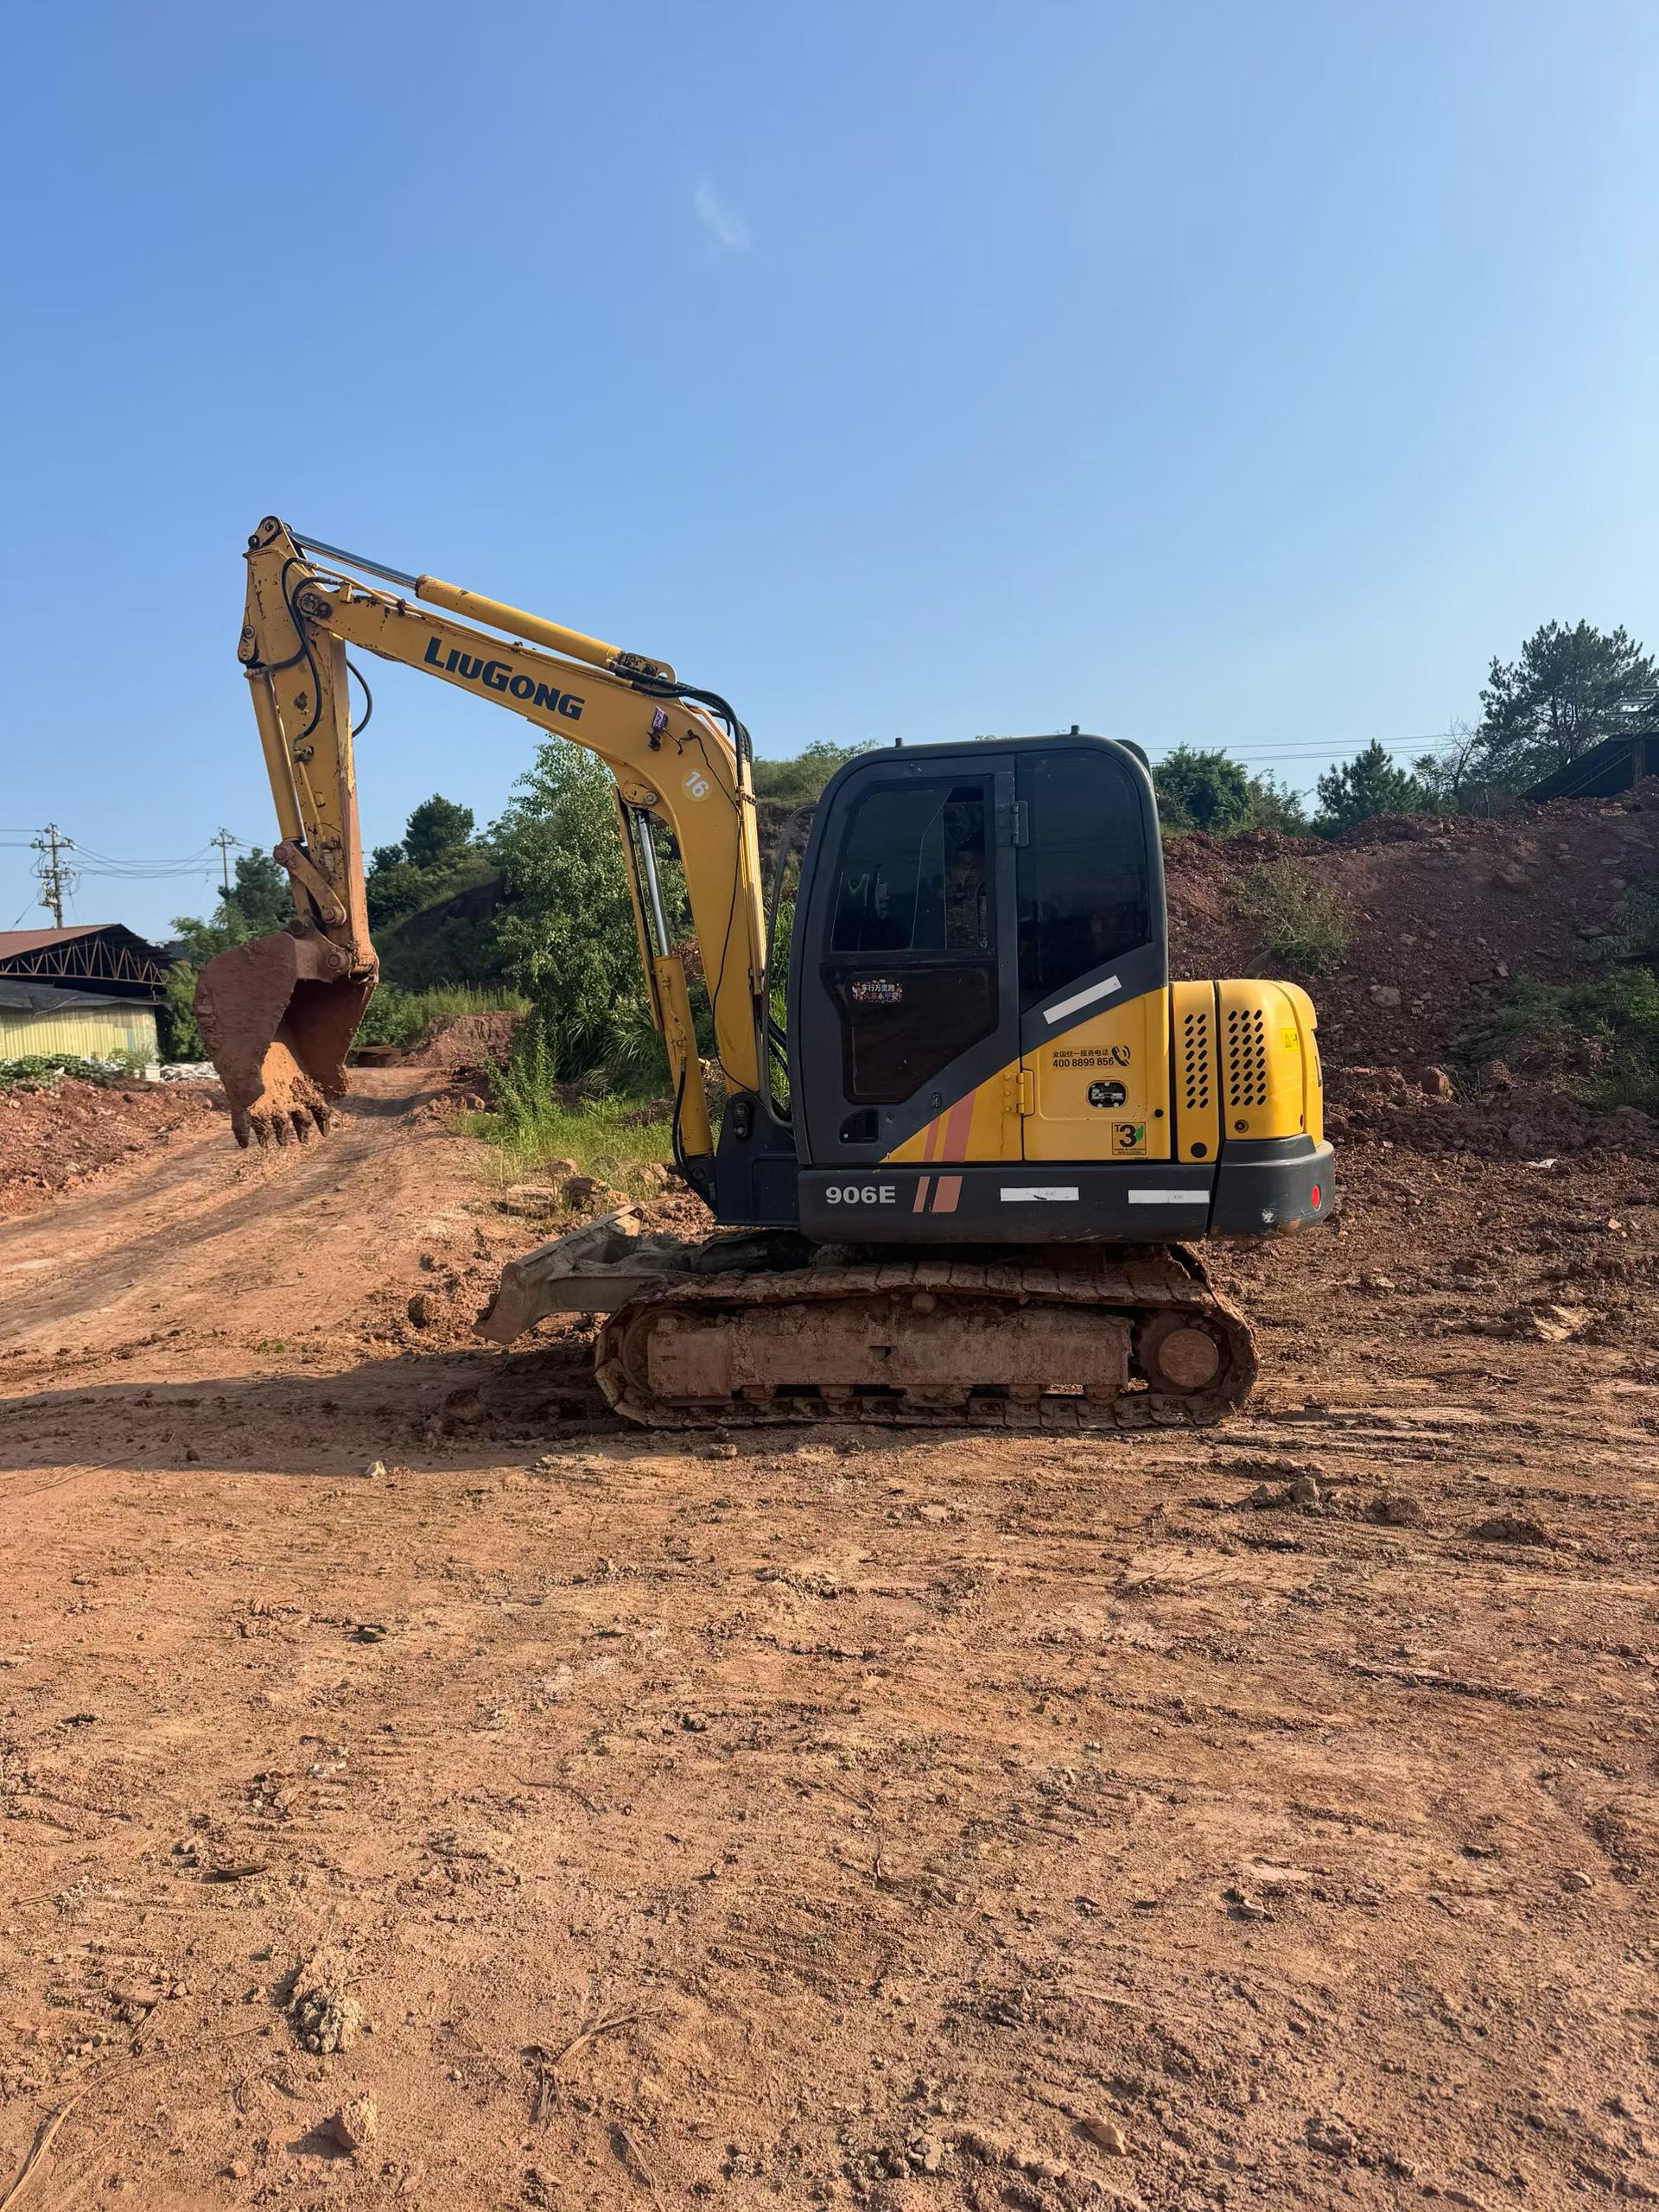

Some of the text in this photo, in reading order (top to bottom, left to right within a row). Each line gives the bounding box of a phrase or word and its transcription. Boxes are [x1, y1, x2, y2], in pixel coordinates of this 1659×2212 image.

[423, 636, 586, 721] LIUGONG
[685, 771, 709, 798] 16
[1052, 1049, 1109, 1058] 全国统一服务电话
[1052, 1057, 1114, 1067] 400 8899 856
[825, 1185, 896, 1205] 906E
